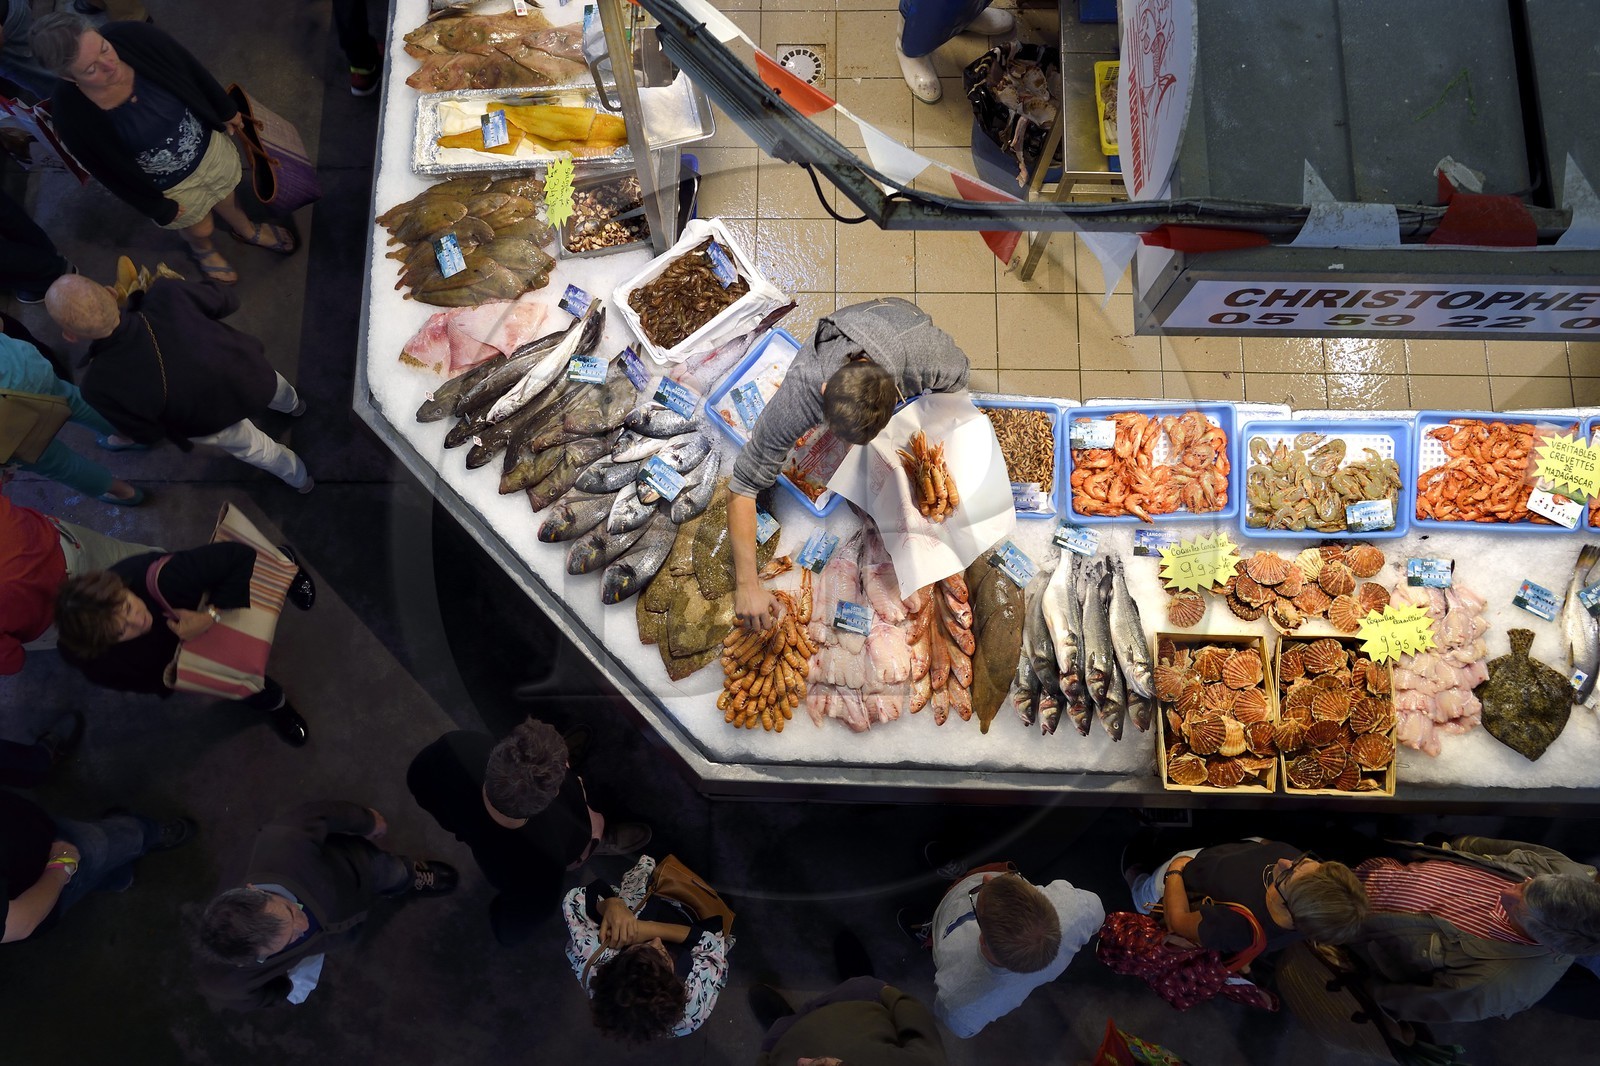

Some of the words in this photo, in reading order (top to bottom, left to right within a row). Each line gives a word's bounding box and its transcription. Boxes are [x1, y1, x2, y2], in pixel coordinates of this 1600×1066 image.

[1224, 288, 1600, 311] CHRISTOPHE
[1208, 312, 1299, 326] 05
[1324, 314, 1416, 326] 59
[1437, 315, 1536, 328] 22
[1550, 450, 1595, 472] CREVETTES
[1564, 464, 1574, 473] DE
[1544, 466, 1594, 488] MADAGASCAR
